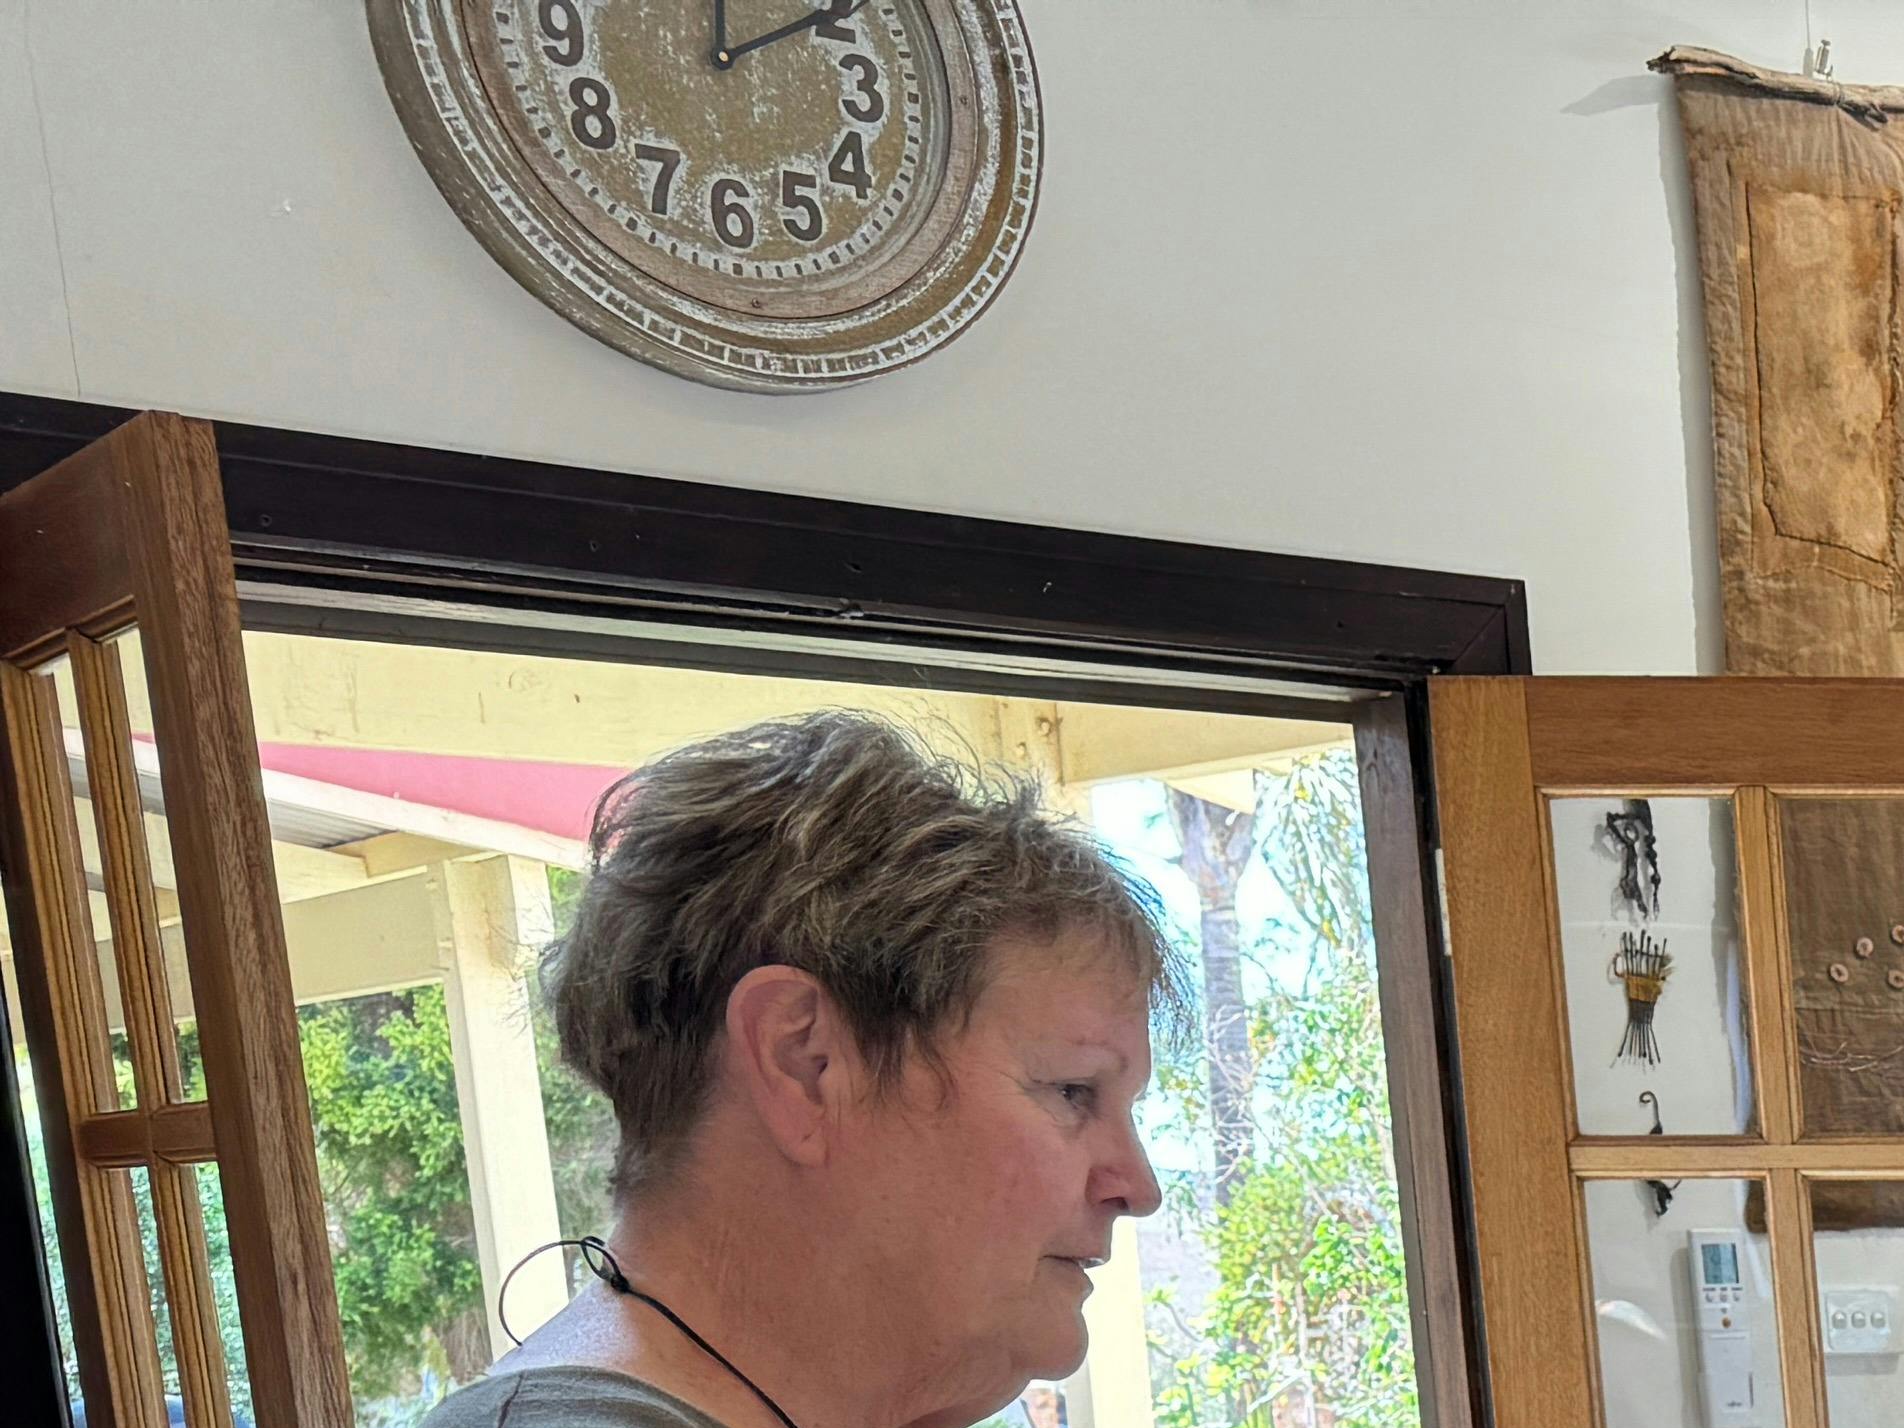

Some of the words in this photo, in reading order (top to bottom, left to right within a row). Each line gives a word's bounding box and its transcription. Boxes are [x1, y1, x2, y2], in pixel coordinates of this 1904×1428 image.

[538, 0, 585, 67] 9
[570, 77, 616, 150] 8
[838, 53, 884, 122] 3
[634, 143, 680, 216] 7
[828, 131, 871, 198] 4
[710, 178, 754, 248] 6
[782, 170, 822, 241] 5
